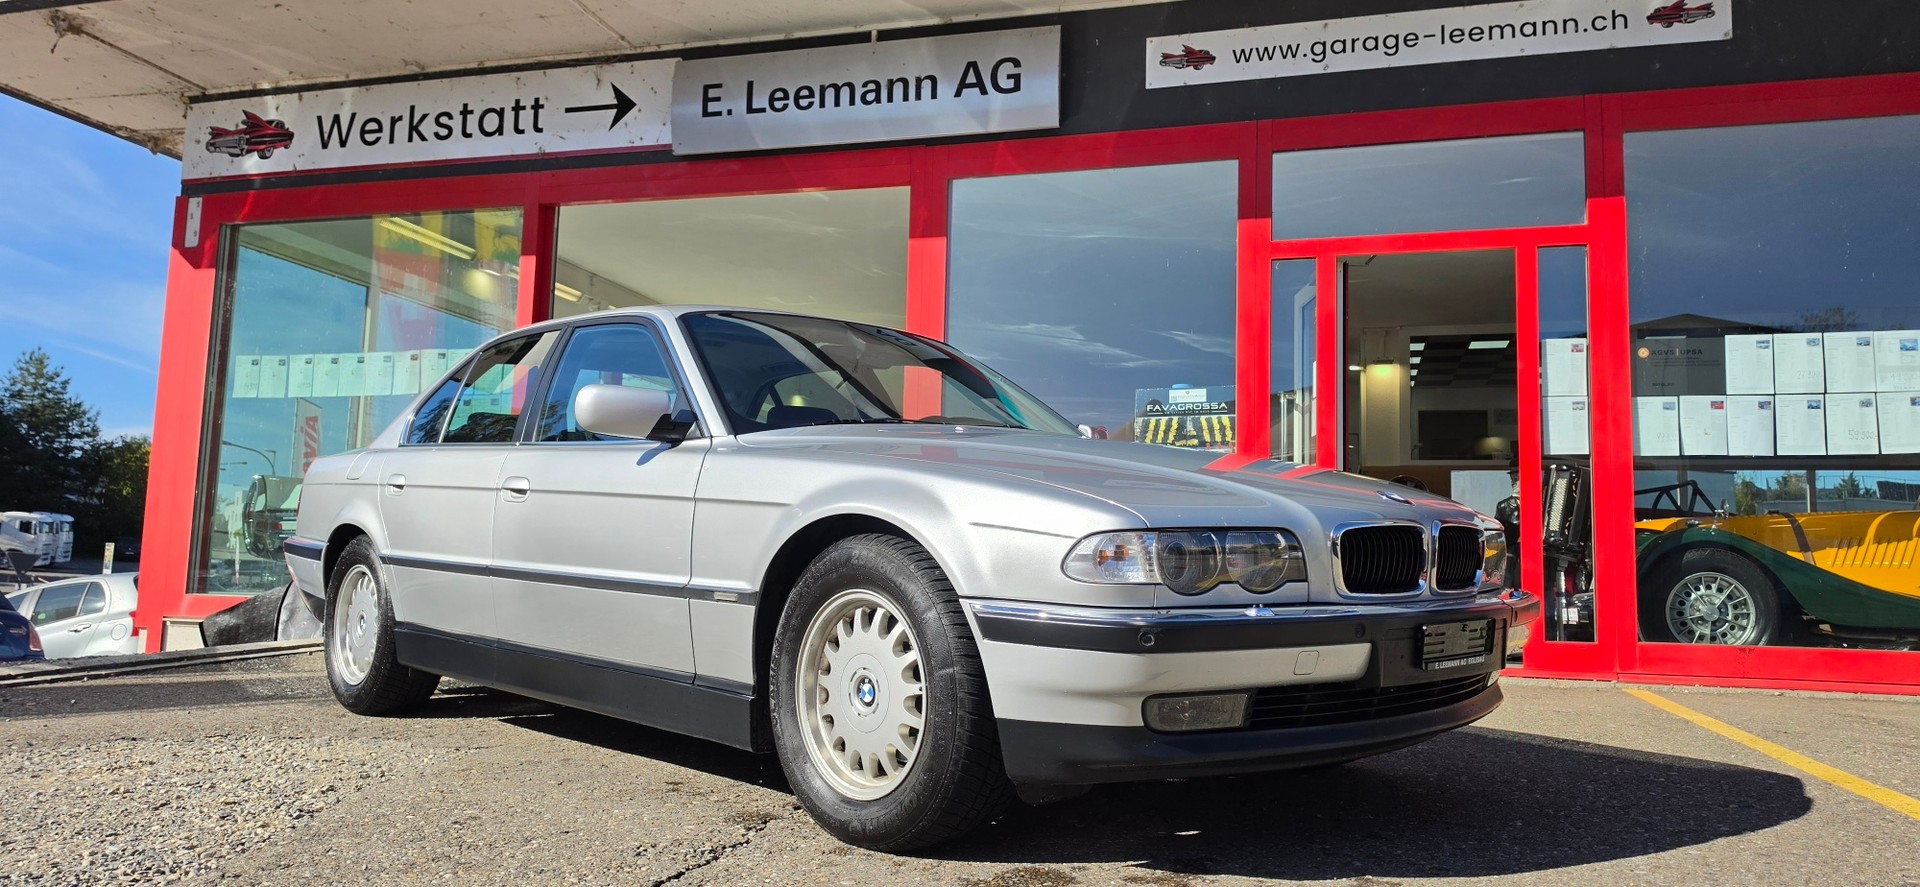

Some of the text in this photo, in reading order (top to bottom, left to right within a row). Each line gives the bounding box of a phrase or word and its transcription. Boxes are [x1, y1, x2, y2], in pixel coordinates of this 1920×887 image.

[1232, 9, 1629, 64] www.garage-leemann.ch
[702, 56, 1022, 118] E. Leemann AG
[316, 97, 545, 150] Werkstatt
[1146, 402, 1228, 412] FAVAGROSSA
